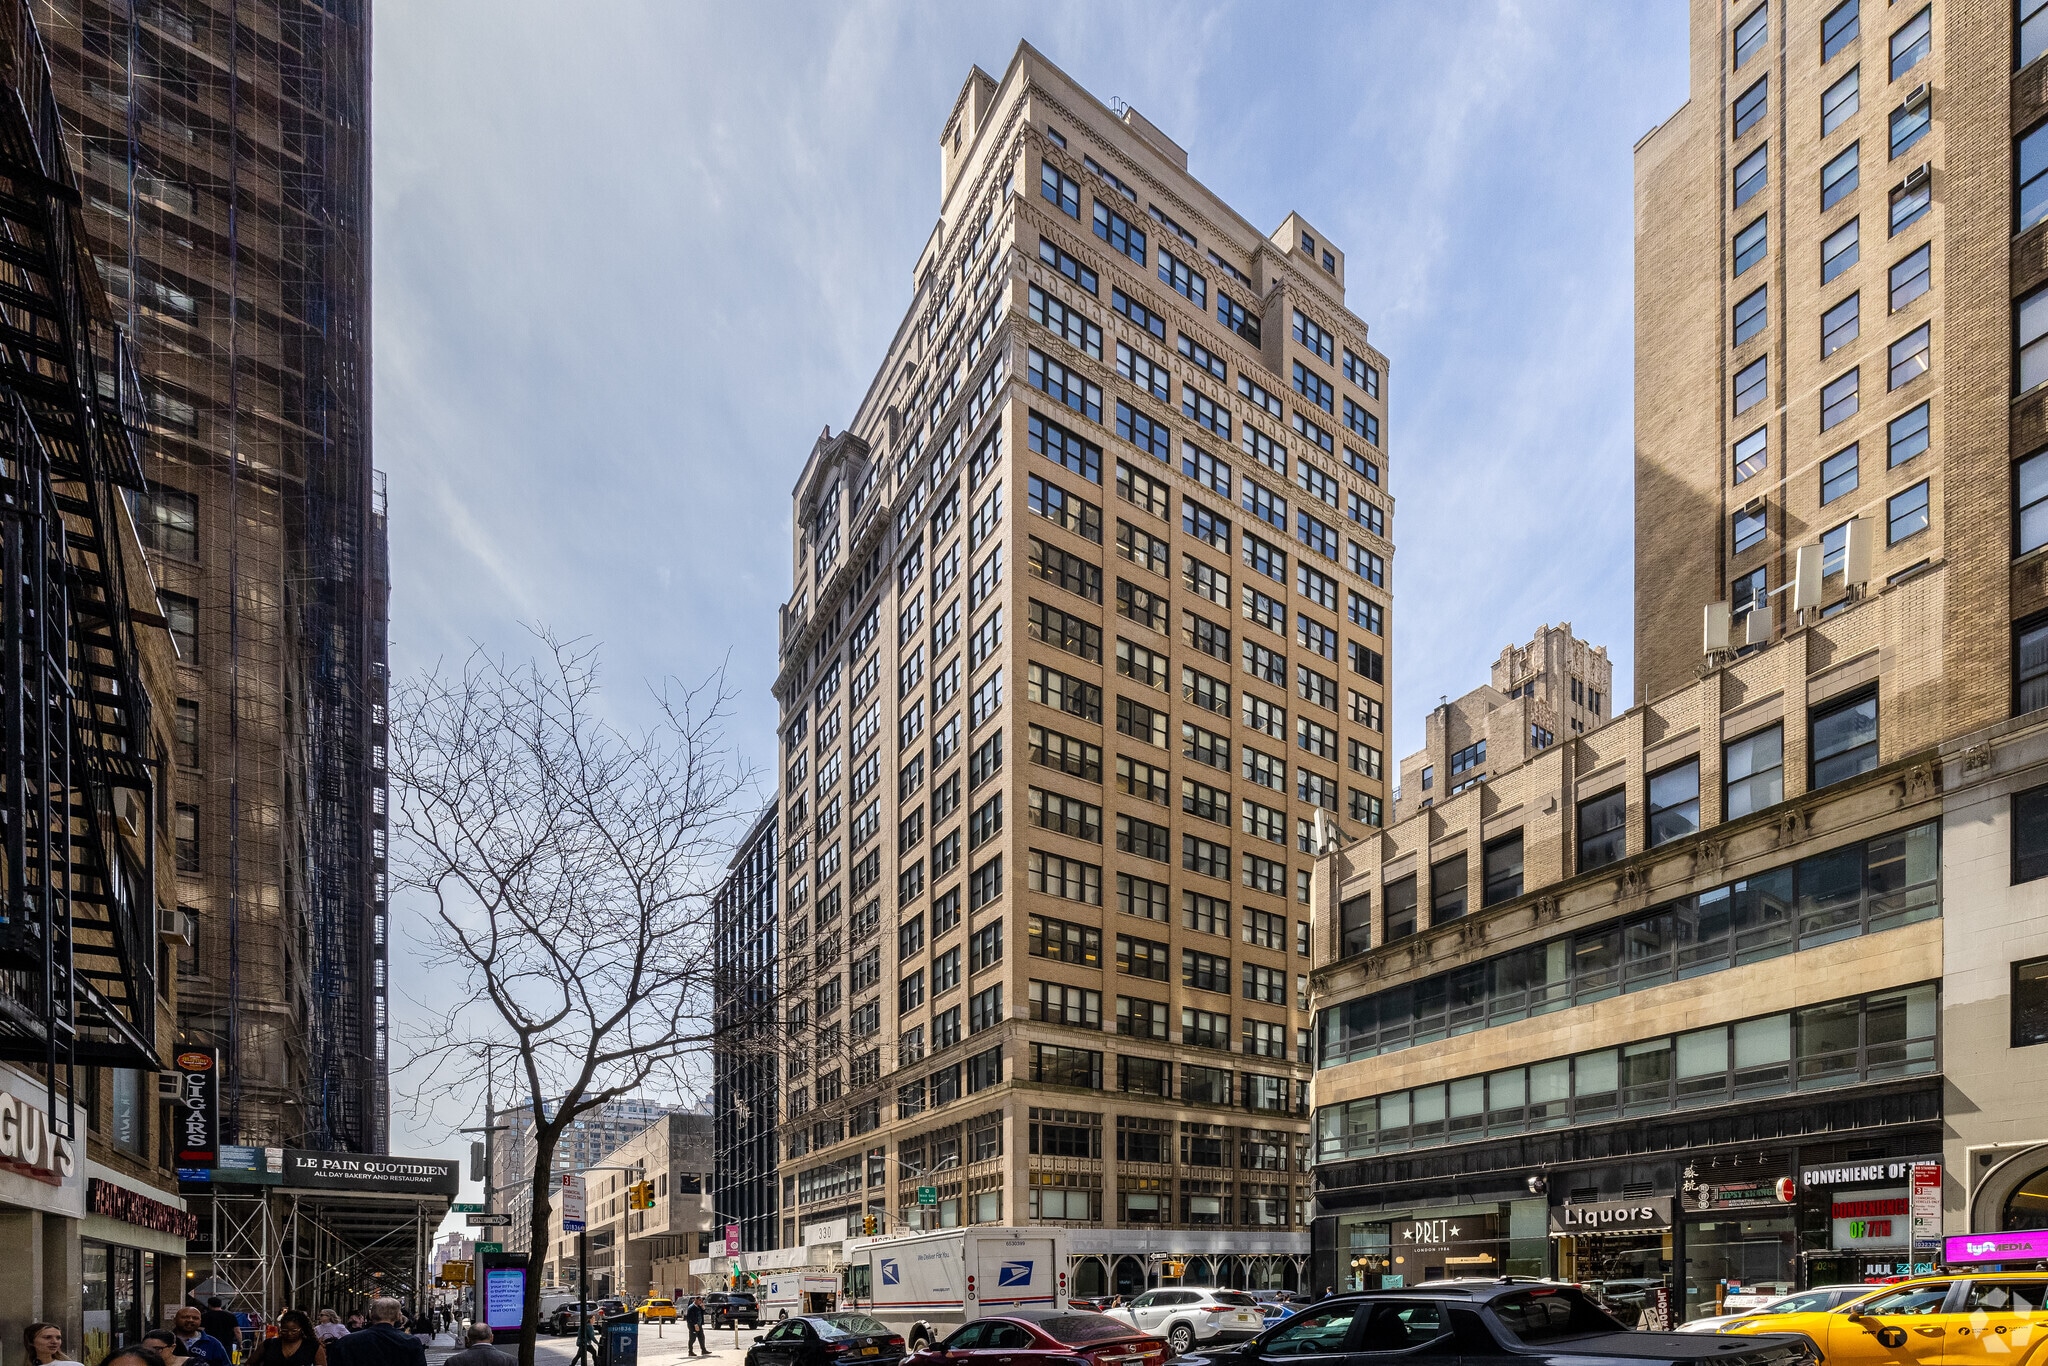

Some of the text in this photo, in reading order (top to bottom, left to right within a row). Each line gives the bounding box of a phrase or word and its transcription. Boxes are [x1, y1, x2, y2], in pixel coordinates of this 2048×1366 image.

[186, 1073, 207, 1146] CIGARS
[0, 1092, 75, 1178] GUYS
[296, 1157, 318, 1168] LE
[322, 1159, 359, 1171] PAIN
[364, 1162, 449, 1176] QUOTIDIEN
[1803, 1163, 1907, 1186] CONVENIENCE OF
[390, 1175, 433, 1183] RESTAURANT
[564, 1176, 569, 1186] 3
[1916, 1187, 1922, 1195] 3
[1565, 1206, 1653, 1227] Liquors
[1832, 1197, 1910, 1219] CONVENIENCE
[818, 1226, 832, 1240] 330
[1415, 1220, 1448, 1244] PRET
[1850, 1220, 1892, 1239] OF 7TH
[923, 1252, 936, 1261] Deliver
[1966, 1241, 1996, 1256] lyft
[1864, 1264, 1893, 1275] JUUL
[620, 1336, 632, 1353] P
[1884, 1330, 1901, 1346] T
